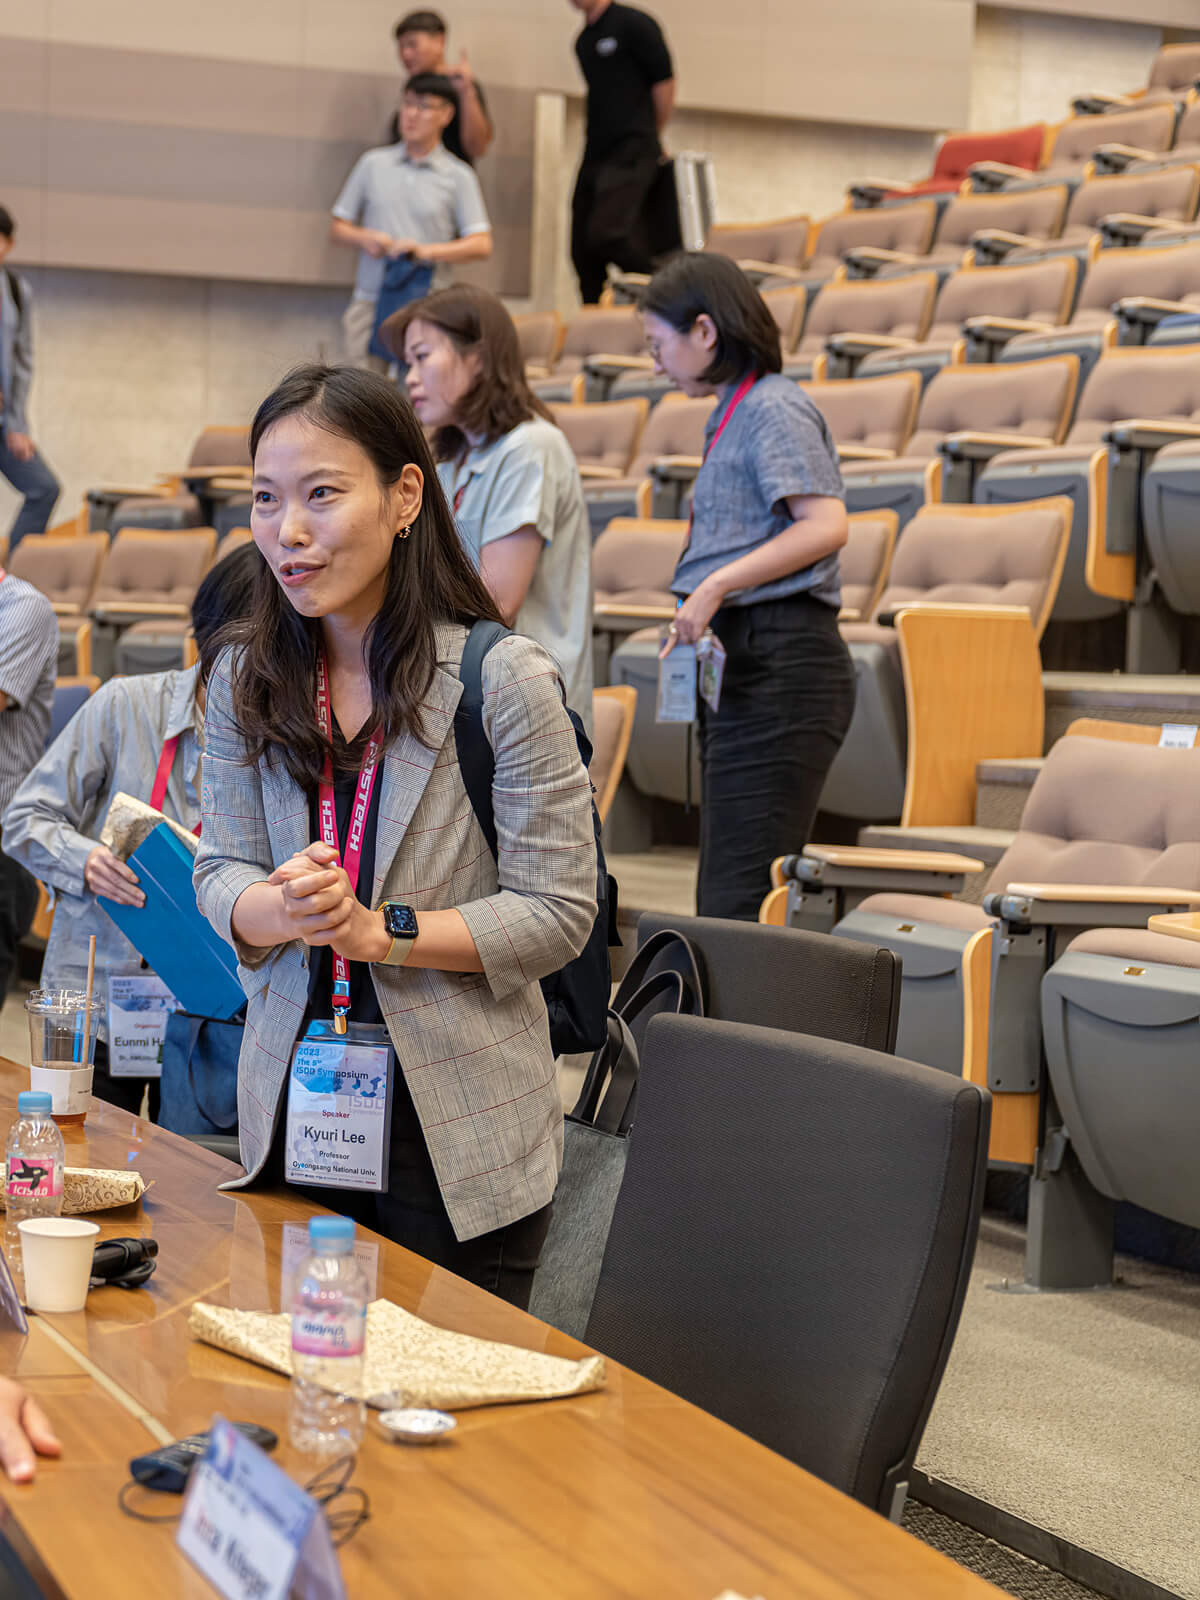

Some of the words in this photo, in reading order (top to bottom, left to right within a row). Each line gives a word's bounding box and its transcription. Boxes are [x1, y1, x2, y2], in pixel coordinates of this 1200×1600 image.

[114, 1036, 149, 1047] Eunmi
[317, 1067, 369, 1080] Symposium
[304, 1125, 338, 1143] Kyuri
[342, 1129, 366, 1144] Lee
[320, 1150, 350, 1160] Professor
[292, 1160, 331, 1172] Gyeongsang
[333, 1165, 359, 1175] National
[360, 1168, 377, 1176] Univ.
